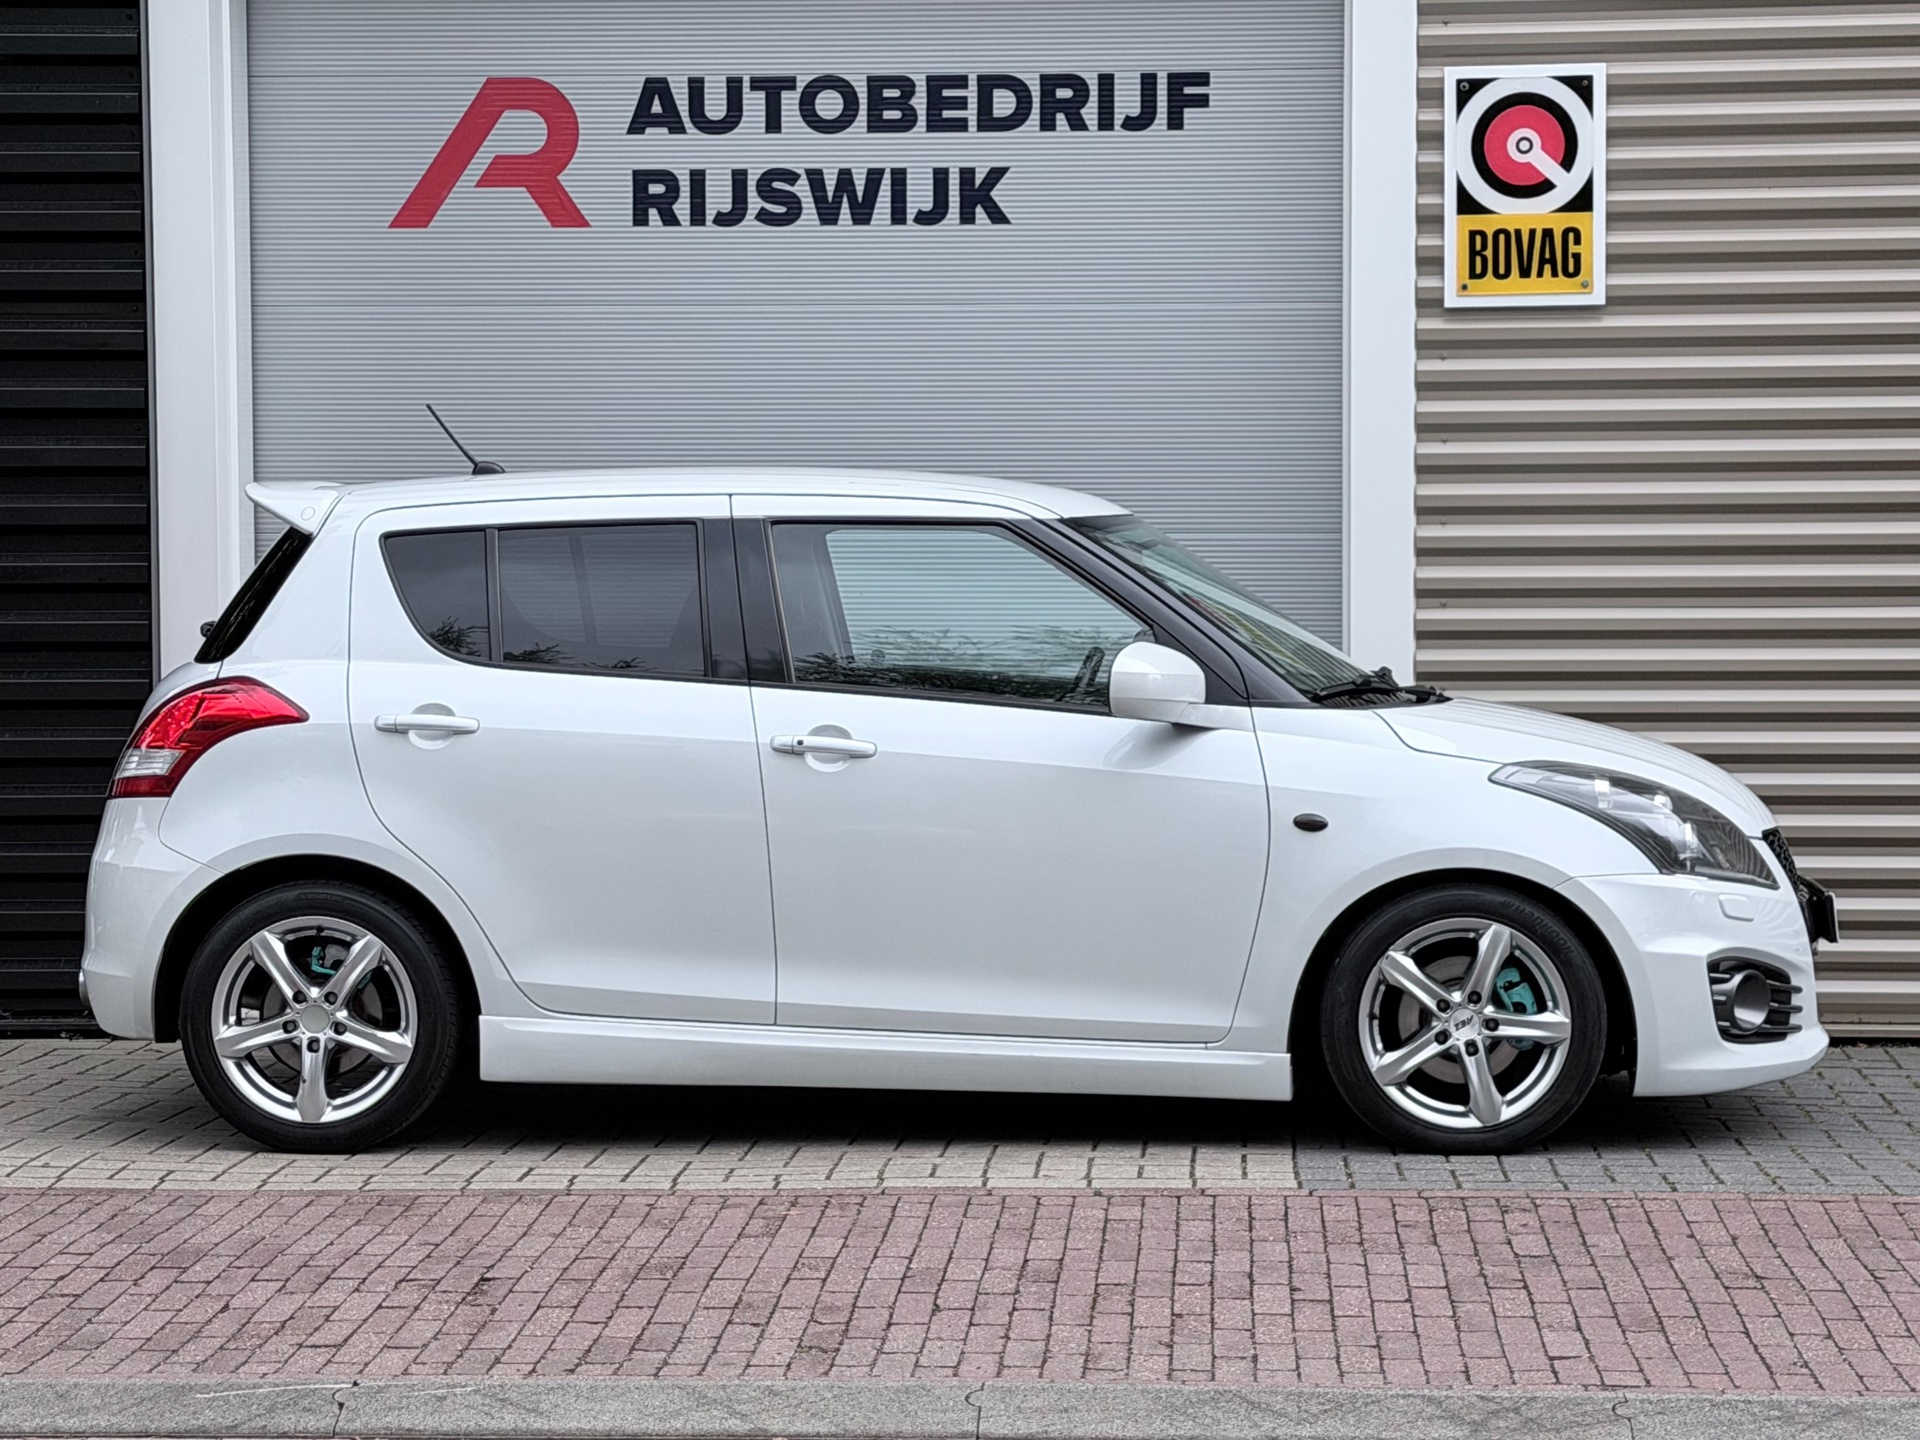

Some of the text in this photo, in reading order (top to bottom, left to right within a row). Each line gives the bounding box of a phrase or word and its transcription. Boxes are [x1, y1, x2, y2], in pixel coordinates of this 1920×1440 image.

[626, 71, 1211, 135] AUTOBEDRIJF
[631, 166, 1012, 228] RIJSWIJK
[1468, 226, 1583, 281] BOVAG
